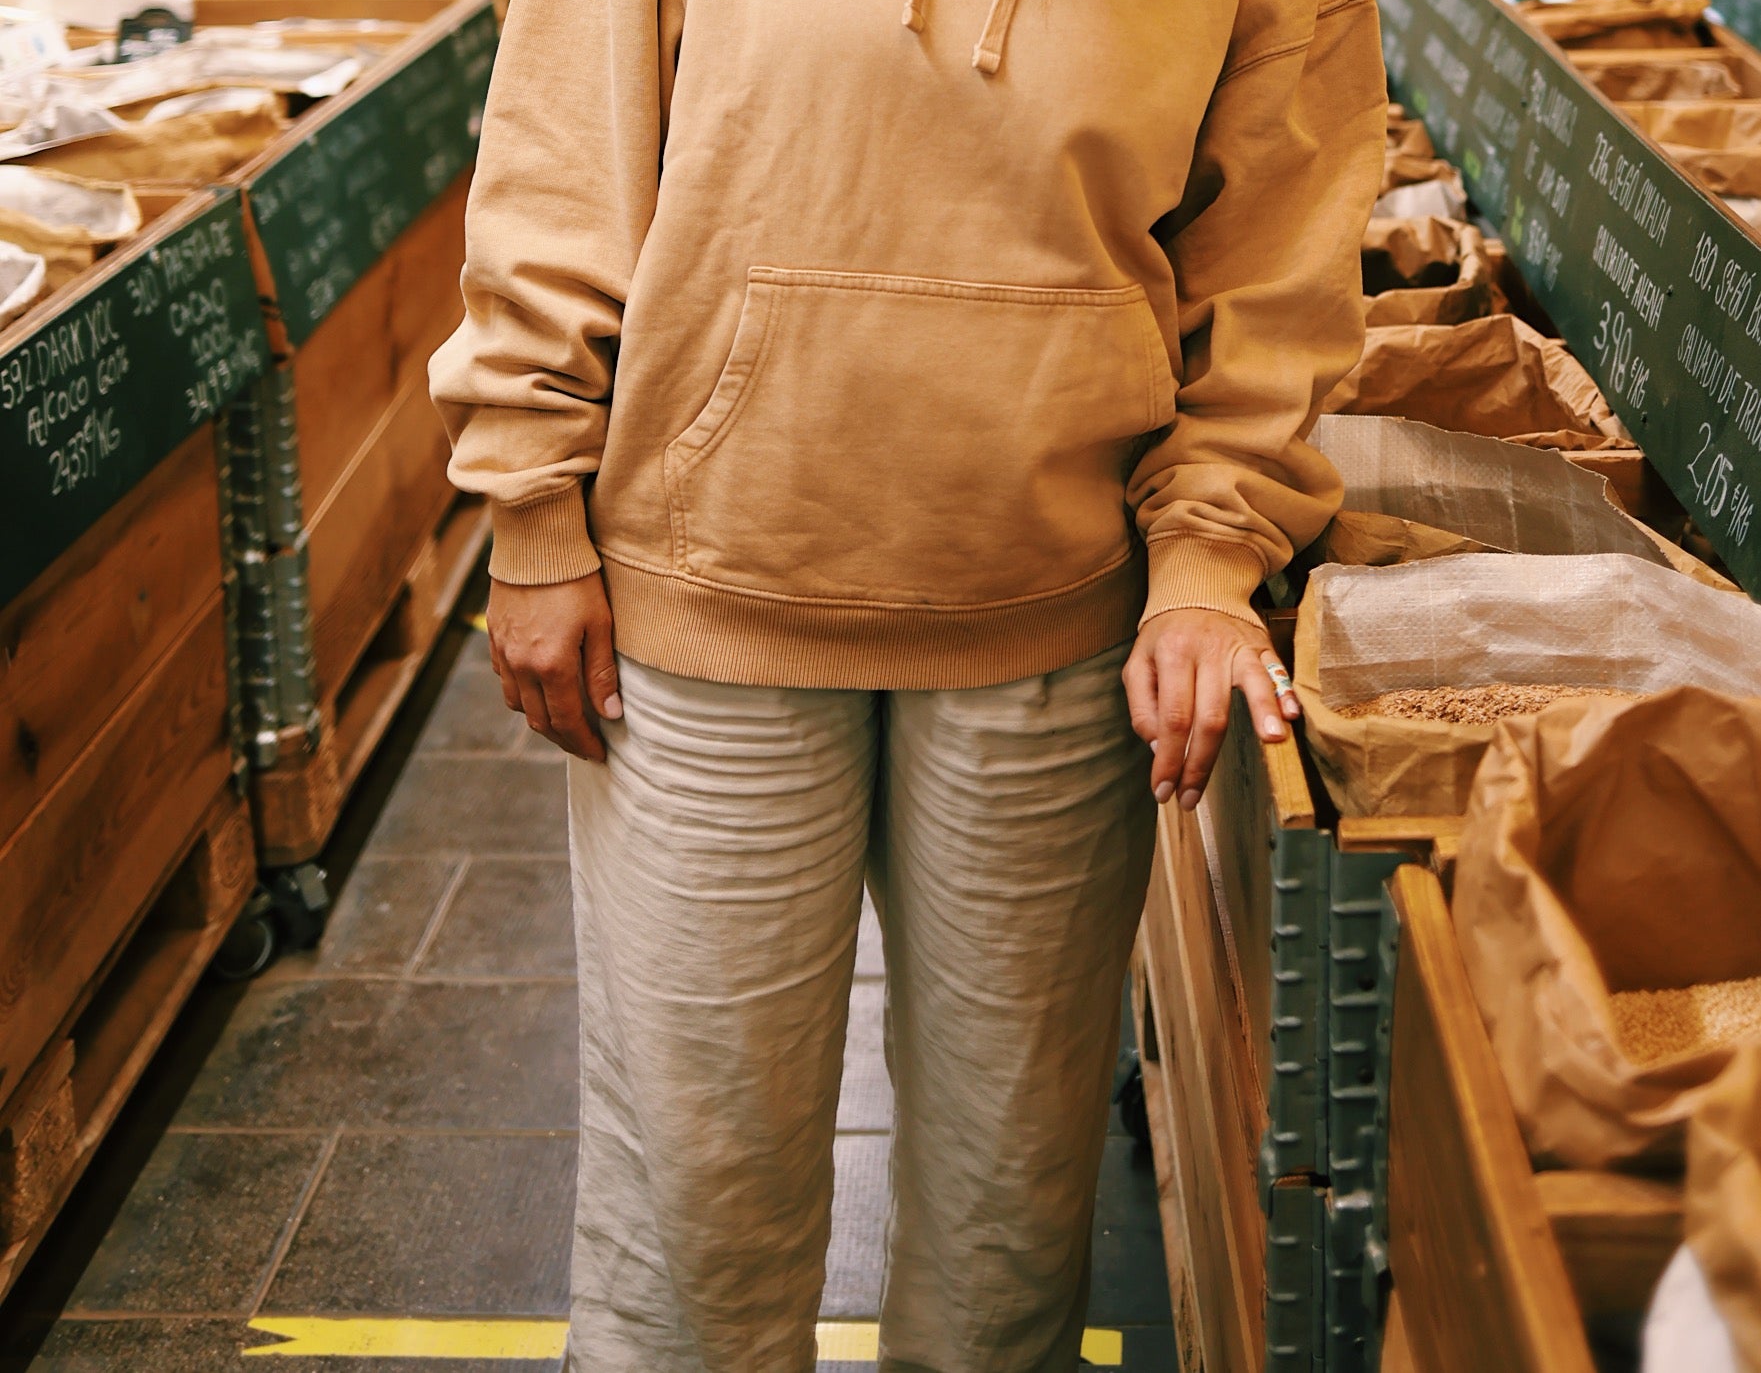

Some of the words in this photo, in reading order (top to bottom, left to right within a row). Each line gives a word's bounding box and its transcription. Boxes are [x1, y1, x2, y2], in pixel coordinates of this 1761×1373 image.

[1689, 231, 1718, 292] 180.
[36, 318, 85, 387] DARK
[1593, 301, 1632, 393] 3,98
[1677, 323, 1725, 397] SALVADO
[1717, 364, 1742, 414] DE
[1687, 422, 1734, 518] 2,05
